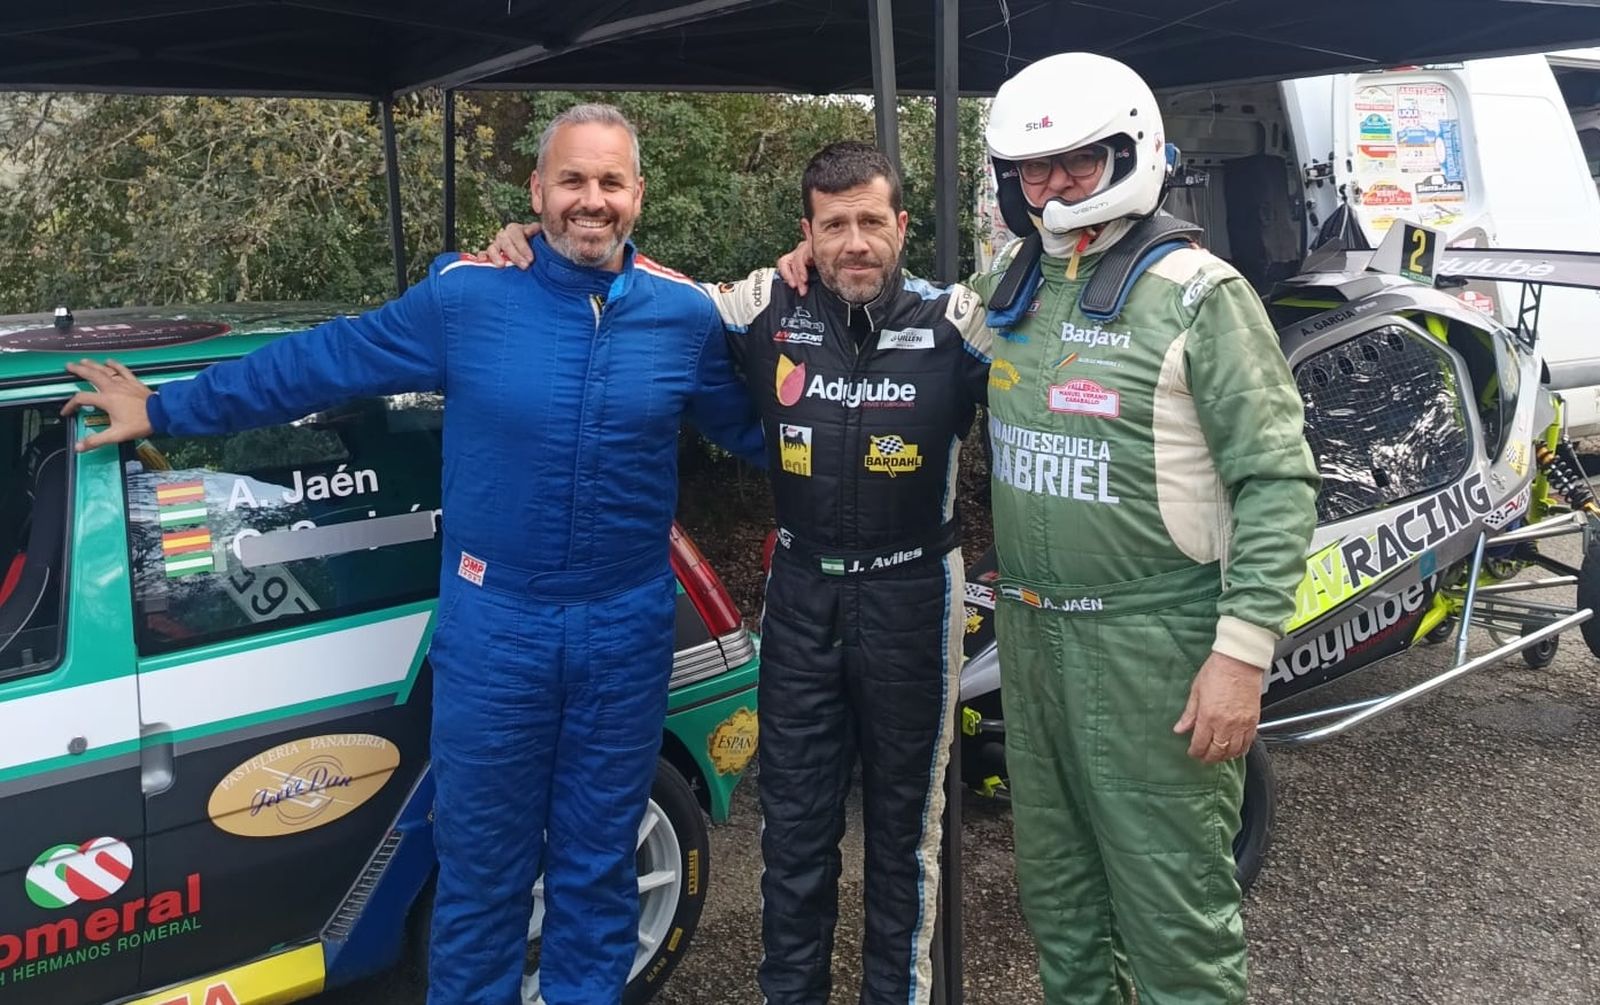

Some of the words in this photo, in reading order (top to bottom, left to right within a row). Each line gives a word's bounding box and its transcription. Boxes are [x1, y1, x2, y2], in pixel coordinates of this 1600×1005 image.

[1409, 229, 1426, 273] 2
[865, 456, 923, 468] BARDAHL
[227, 478, 269, 512] A.
[282, 464, 380, 505] Jaén
[848, 560, 865, 573] J.
[870, 547, 923, 570] Aviles
[1044, 597, 1058, 610] A.
[13, 942, 112, 983] HERMANOS
[118, 917, 203, 952] ROMERAL
